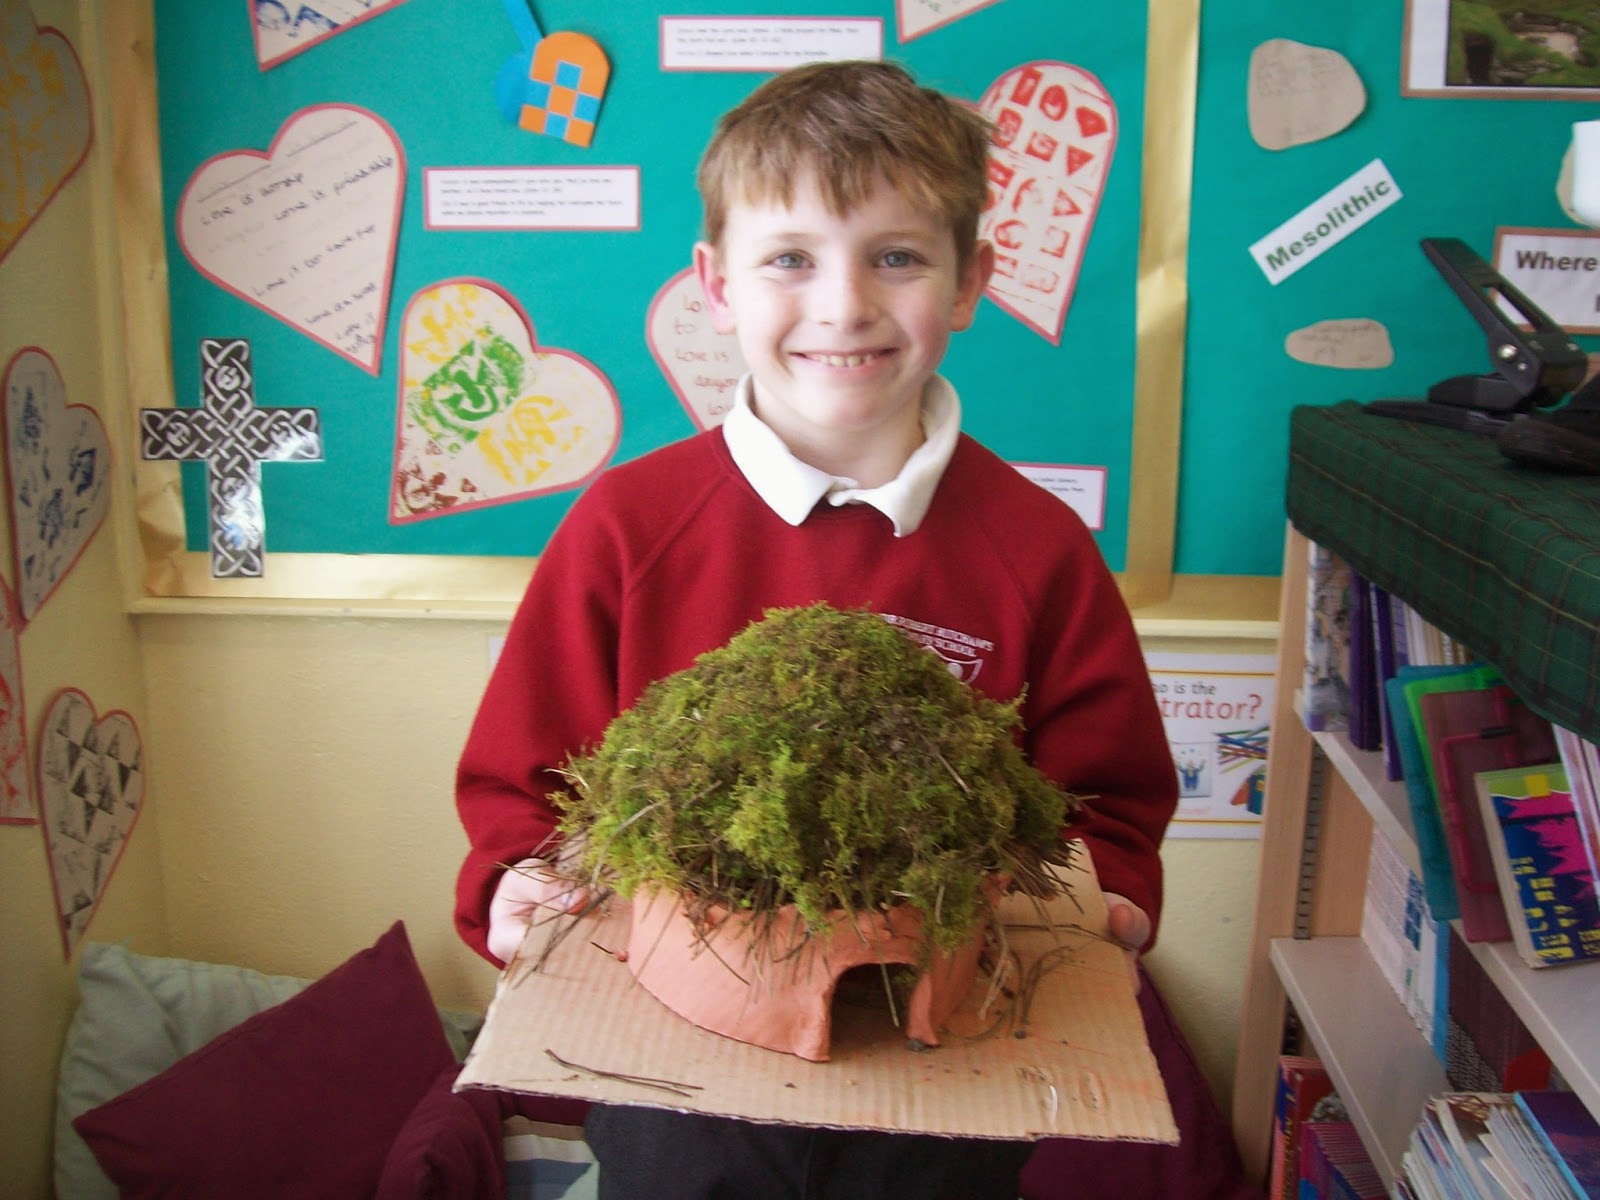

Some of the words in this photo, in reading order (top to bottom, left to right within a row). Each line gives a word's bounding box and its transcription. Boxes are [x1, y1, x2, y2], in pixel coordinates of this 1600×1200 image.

[1264, 179, 1393, 272] Mesolithic
[1515, 249, 1599, 272] Where
[1174, 681, 1187, 695] is
[1192, 681, 1217, 696] the
[1160, 693, 1263, 720] trator?
